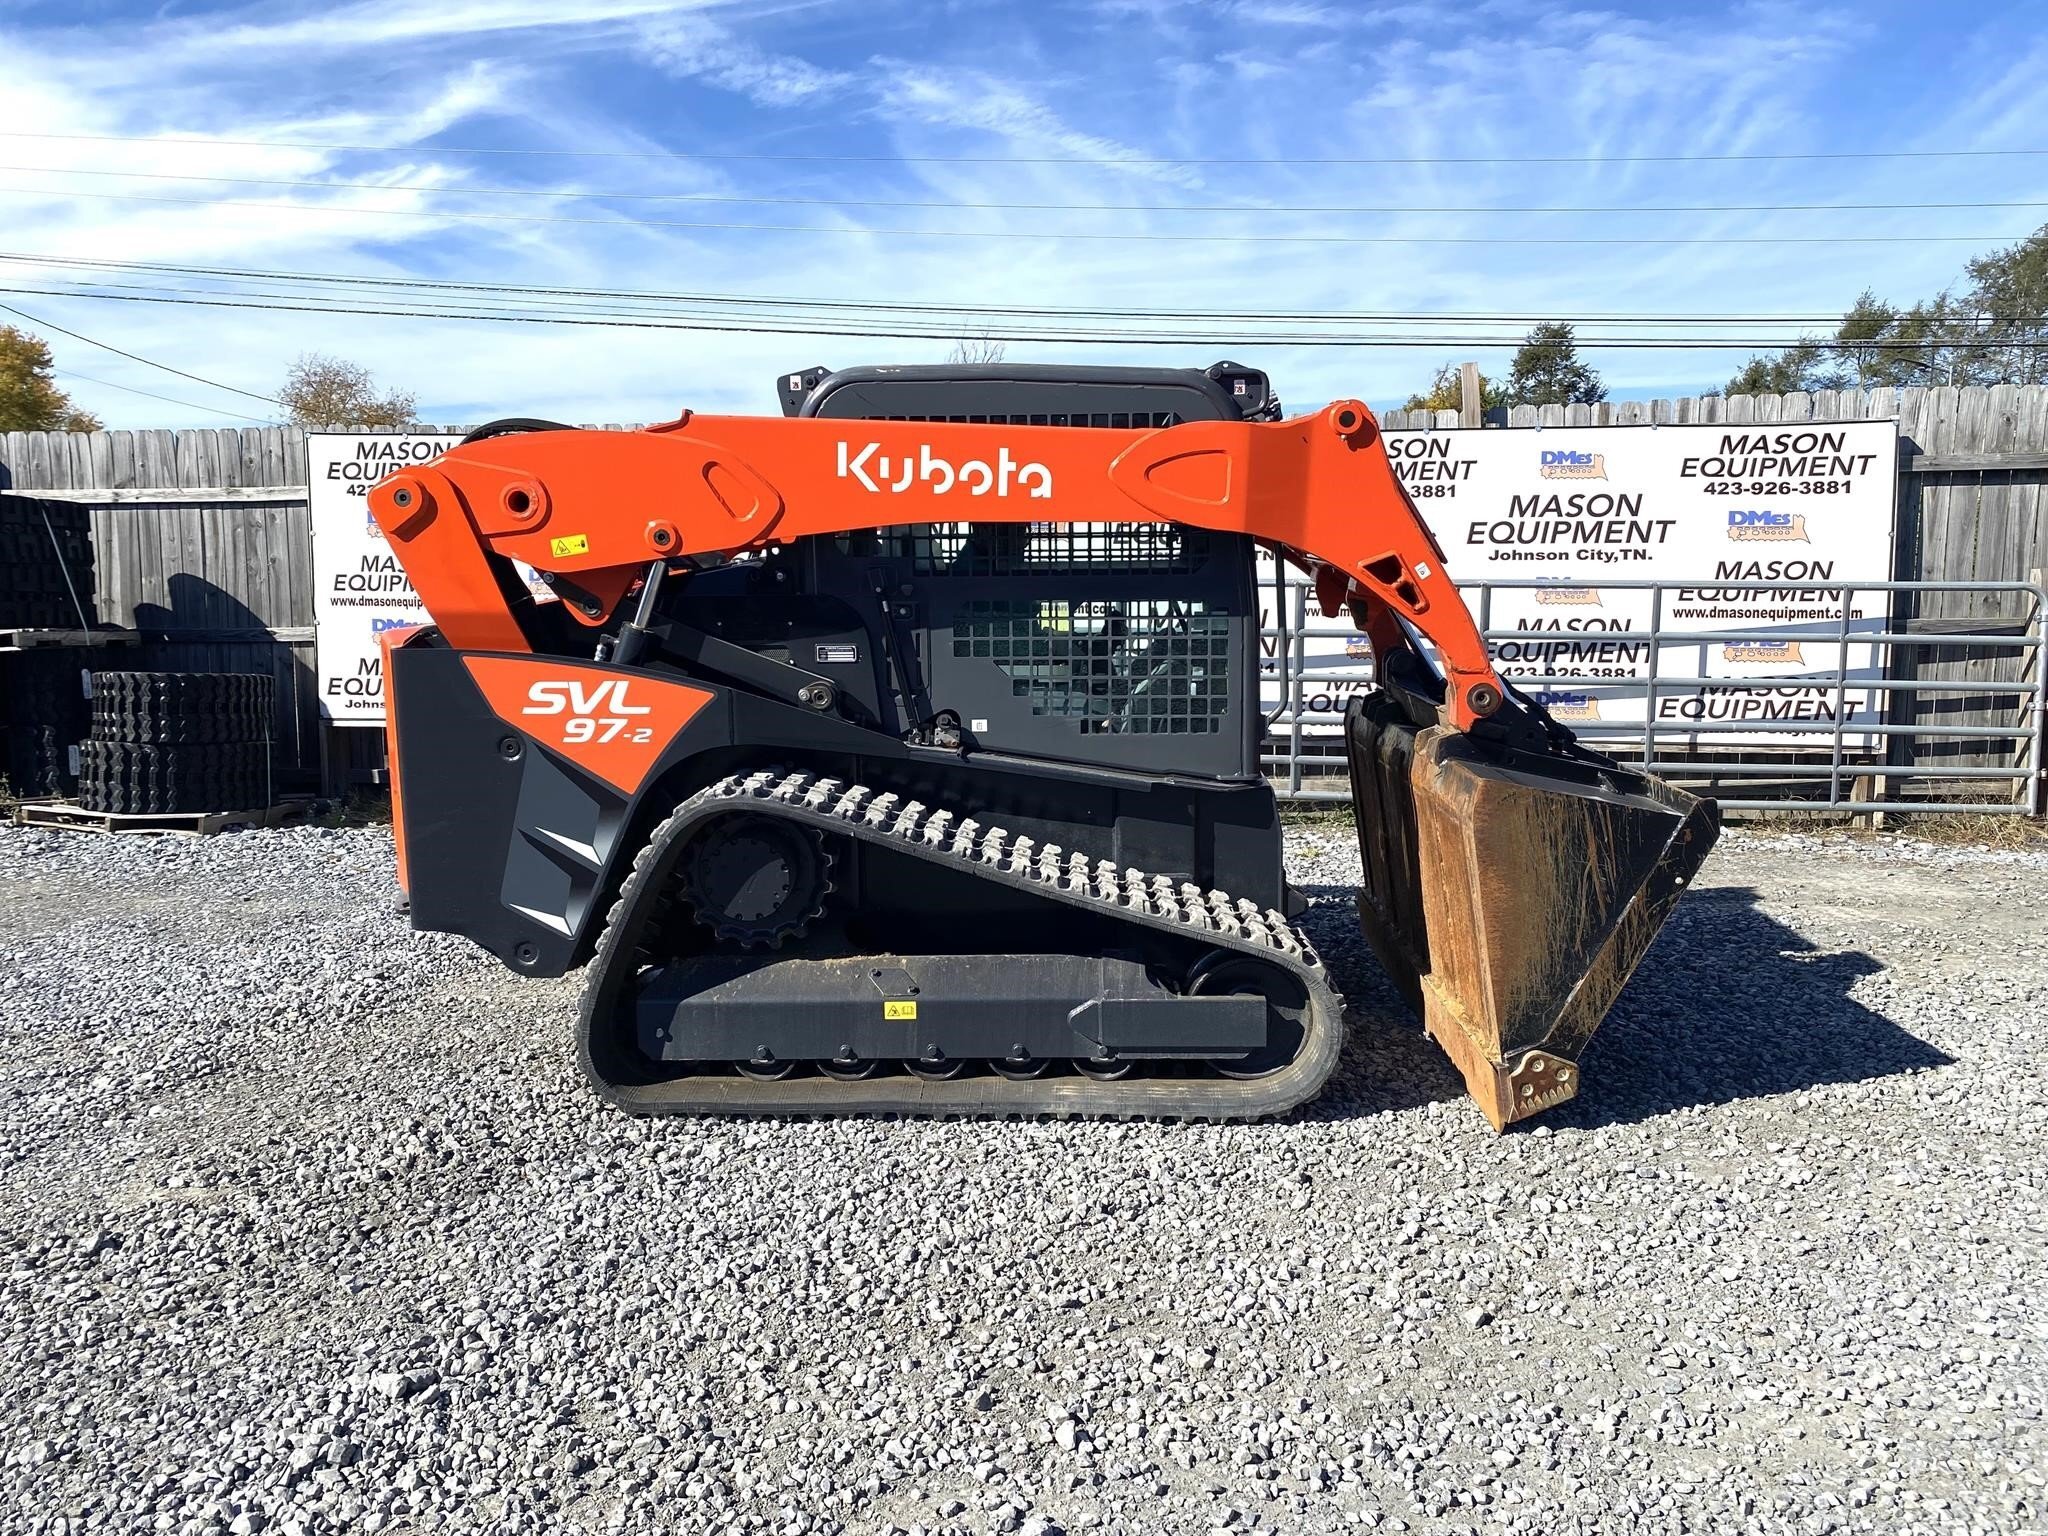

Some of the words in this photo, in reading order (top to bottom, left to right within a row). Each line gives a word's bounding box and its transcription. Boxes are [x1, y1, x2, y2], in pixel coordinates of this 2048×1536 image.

[1719, 432, 1846, 455] MASON
[837, 441, 1053, 498] Kubota
[1680, 455, 1877, 478] EQUIPMENT
[1703, 480, 1852, 495] 423-926-3881
[1508, 493, 1643, 518] MASON
[1466, 520, 1677, 544] EQUIPMENT
[1488, 550, 1569, 560] Johnson
[1714, 560, 1834, 580] MASON
[1673, 606, 1863, 621] www.dmasonequipment.cm
[521, 680, 651, 715] SVL
[1659, 699, 1863, 721] EQUIPMENT
[562, 718, 653, 743] 97-2
